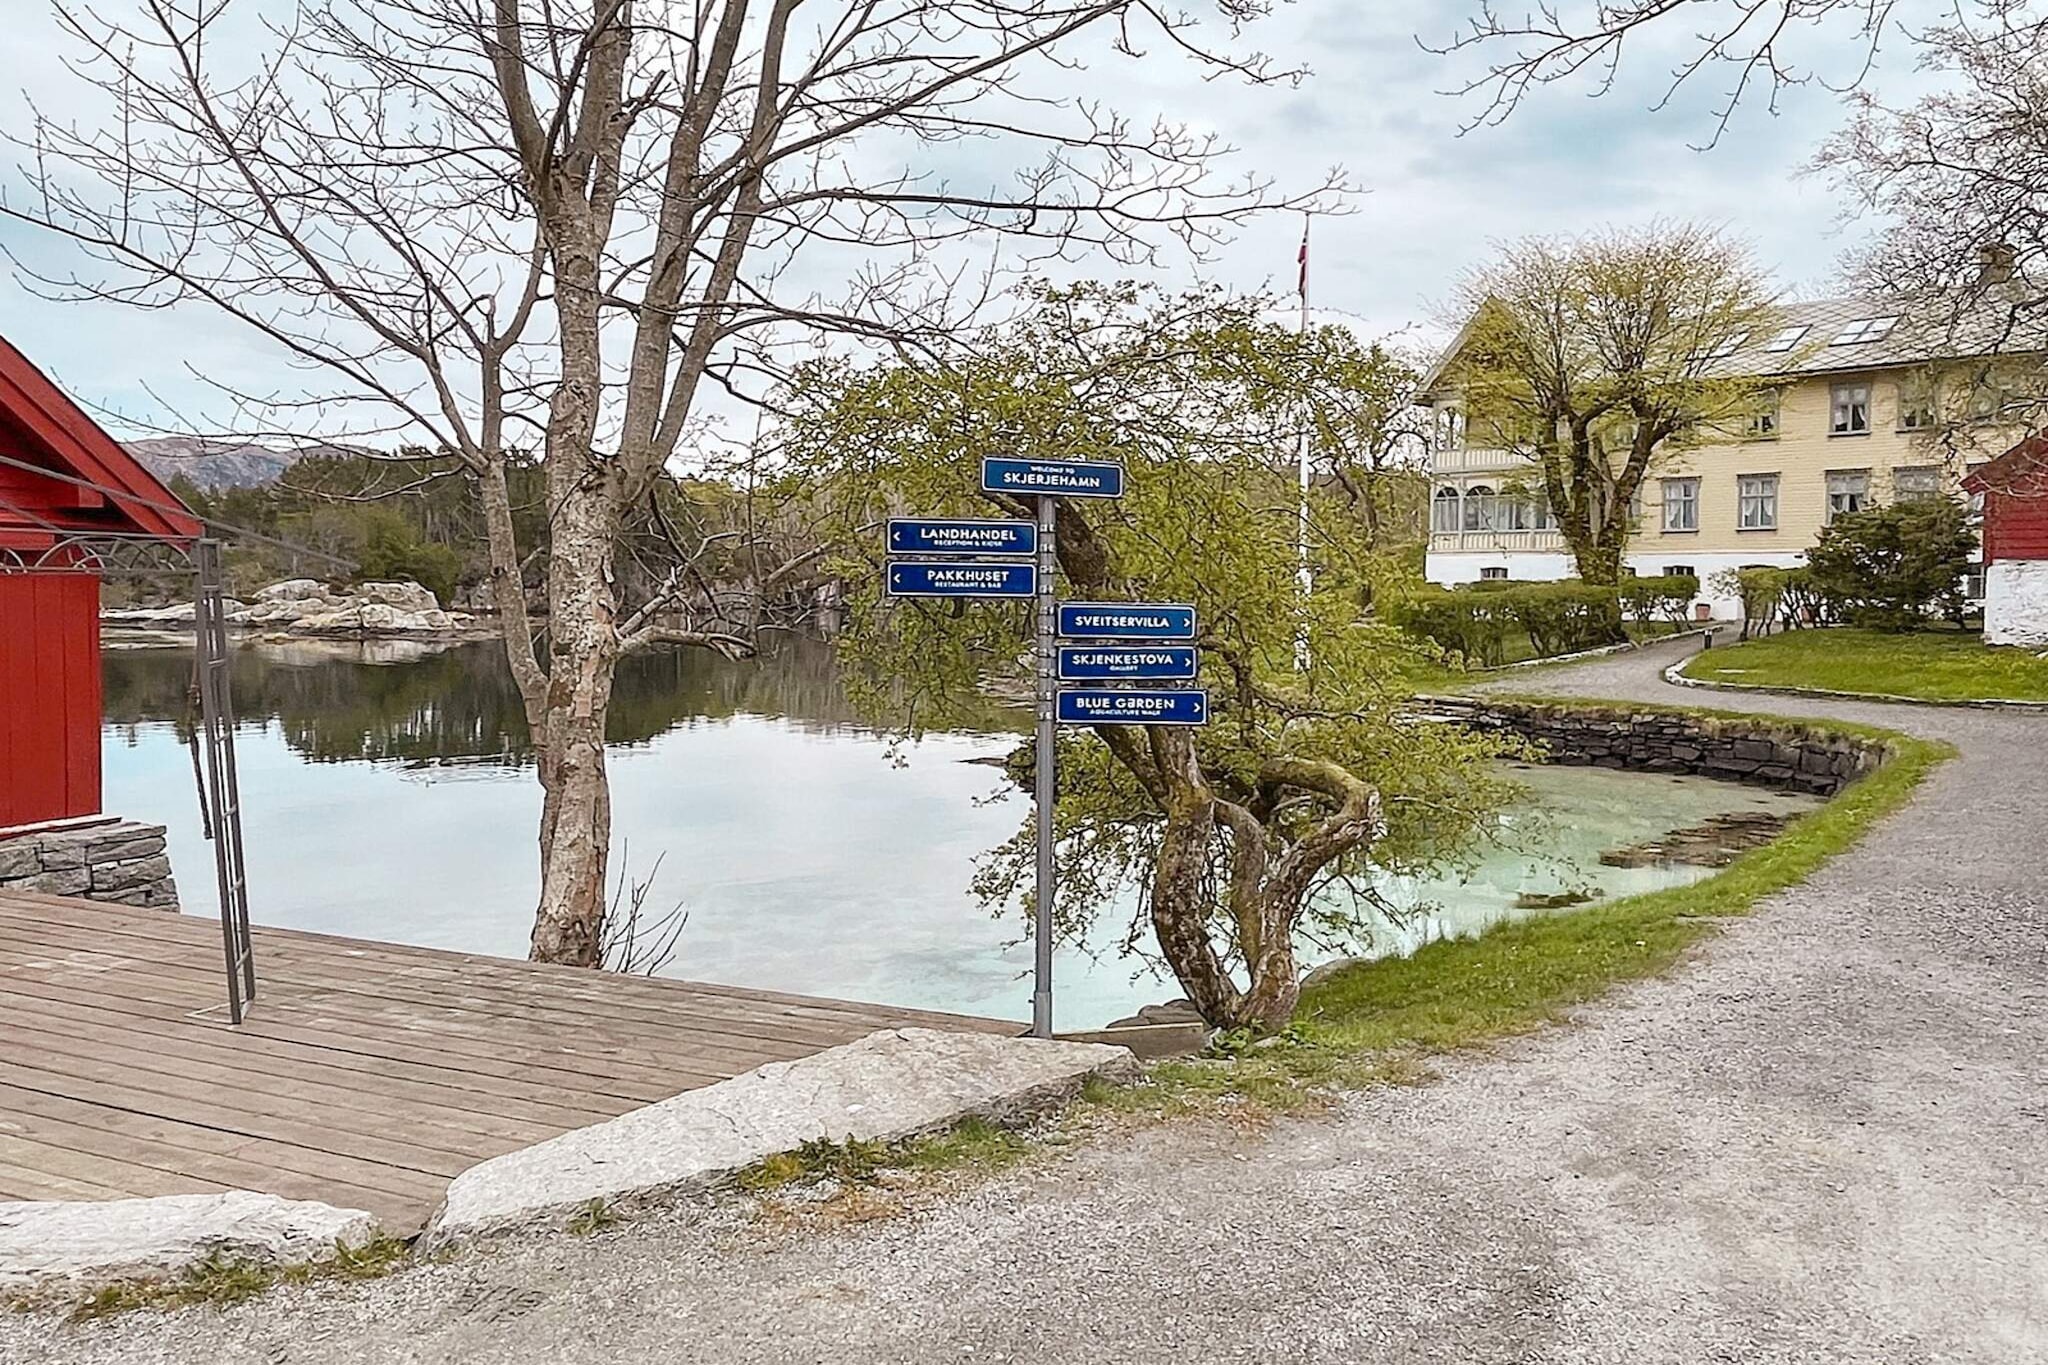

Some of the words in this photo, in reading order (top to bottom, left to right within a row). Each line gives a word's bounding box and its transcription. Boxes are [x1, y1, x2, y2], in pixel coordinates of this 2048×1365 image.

[1003, 472, 1100, 488] SKJERJEHAMN
[920, 528, 1017, 541] LANDHANDEL
[927, 570, 1010, 582] PAKKHUSET
[1074, 615, 1170, 628] SVEITSERVILLA
[1072, 654, 1174, 665] SKJENKESTOVA
[1076, 697, 1110, 709] BLUE
